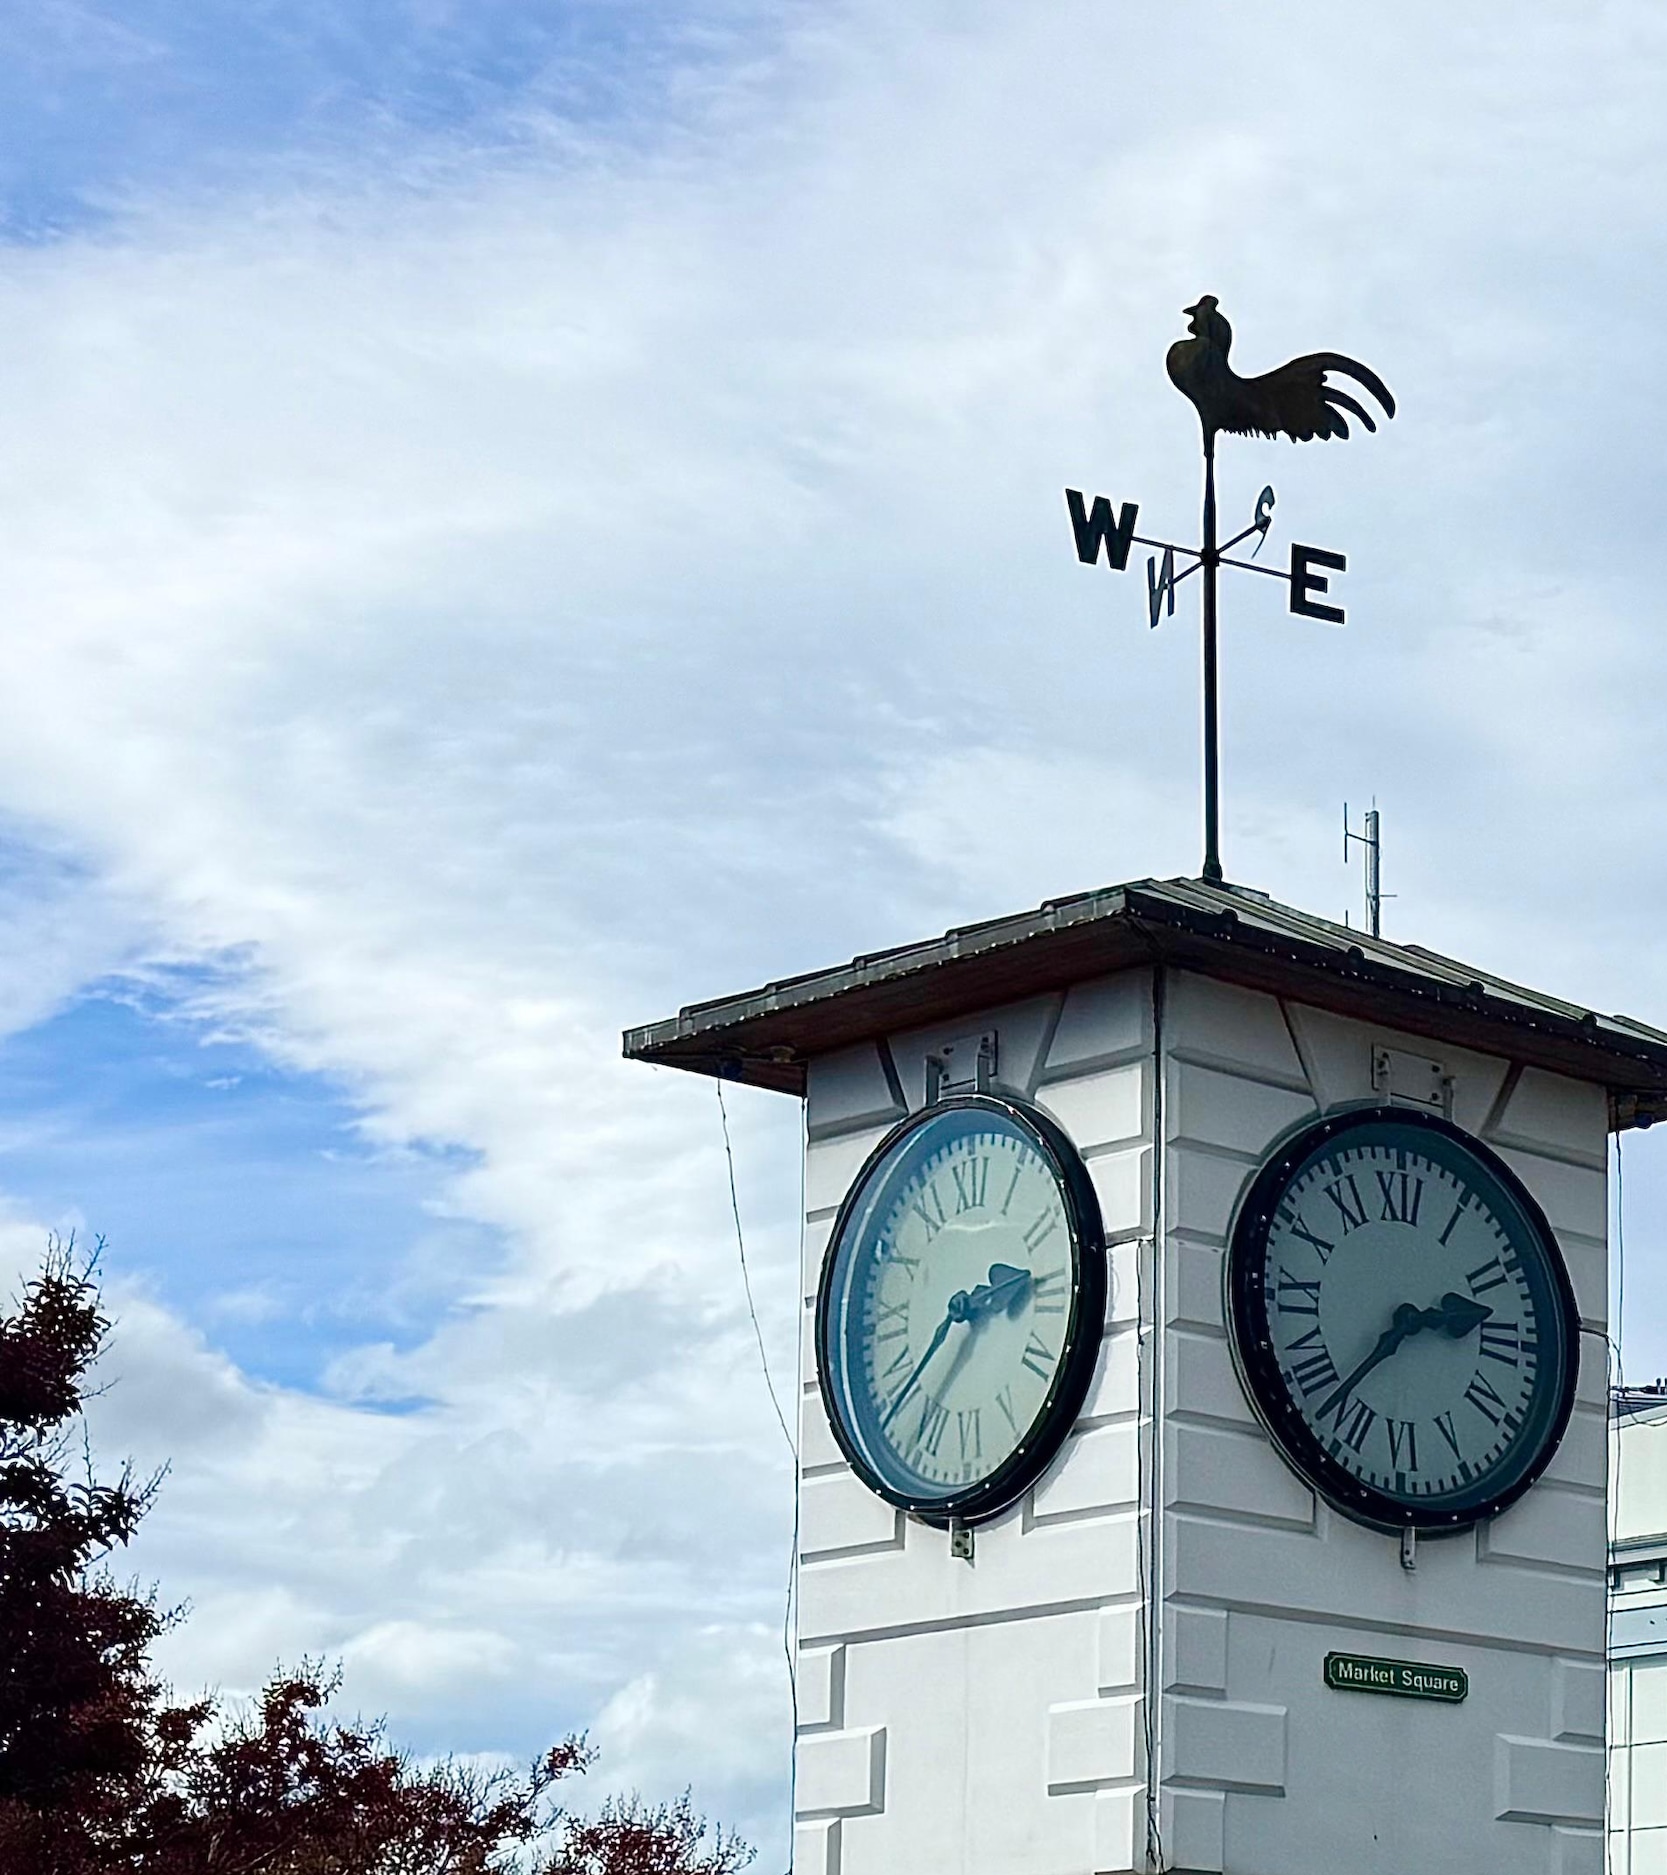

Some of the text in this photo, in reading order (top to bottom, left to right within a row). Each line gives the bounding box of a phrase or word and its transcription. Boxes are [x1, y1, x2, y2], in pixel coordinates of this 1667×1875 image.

[1065, 488, 1139, 571] W
[1290, 543, 1346, 624] E
[912, 1181, 949, 1243] XI
[951, 1156, 990, 1215] XII
[1001, 1165, 1023, 1217] I
[1323, 1173, 1370, 1236] XI
[1375, 1170, 1424, 1227] XII
[1022, 1203, 1059, 1254] II
[1289, 1217, 1336, 1266] X
[1438, 1204, 1465, 1246] I
[1031, 1267, 1066, 1315] III
[1277, 1266, 1321, 1317] IX
[1464, 1256, 1509, 1297] II
[876, 1300, 910, 1343] IX
[1479, 1321, 1519, 1369] III
[1020, 1330, 1057, 1383] IV
[1285, 1324, 1341, 1398] VIII
[995, 1384, 1023, 1442] V
[1464, 1369, 1507, 1426] IV
[914, 1394, 951, 1458] VII
[957, 1408, 983, 1461] VI
[1332, 1397, 1379, 1455] VII
[1385, 1417, 1419, 1472] VI
[1433, 1410, 1462, 1462] V
[1338, 1660, 1459, 1692] Market Square
